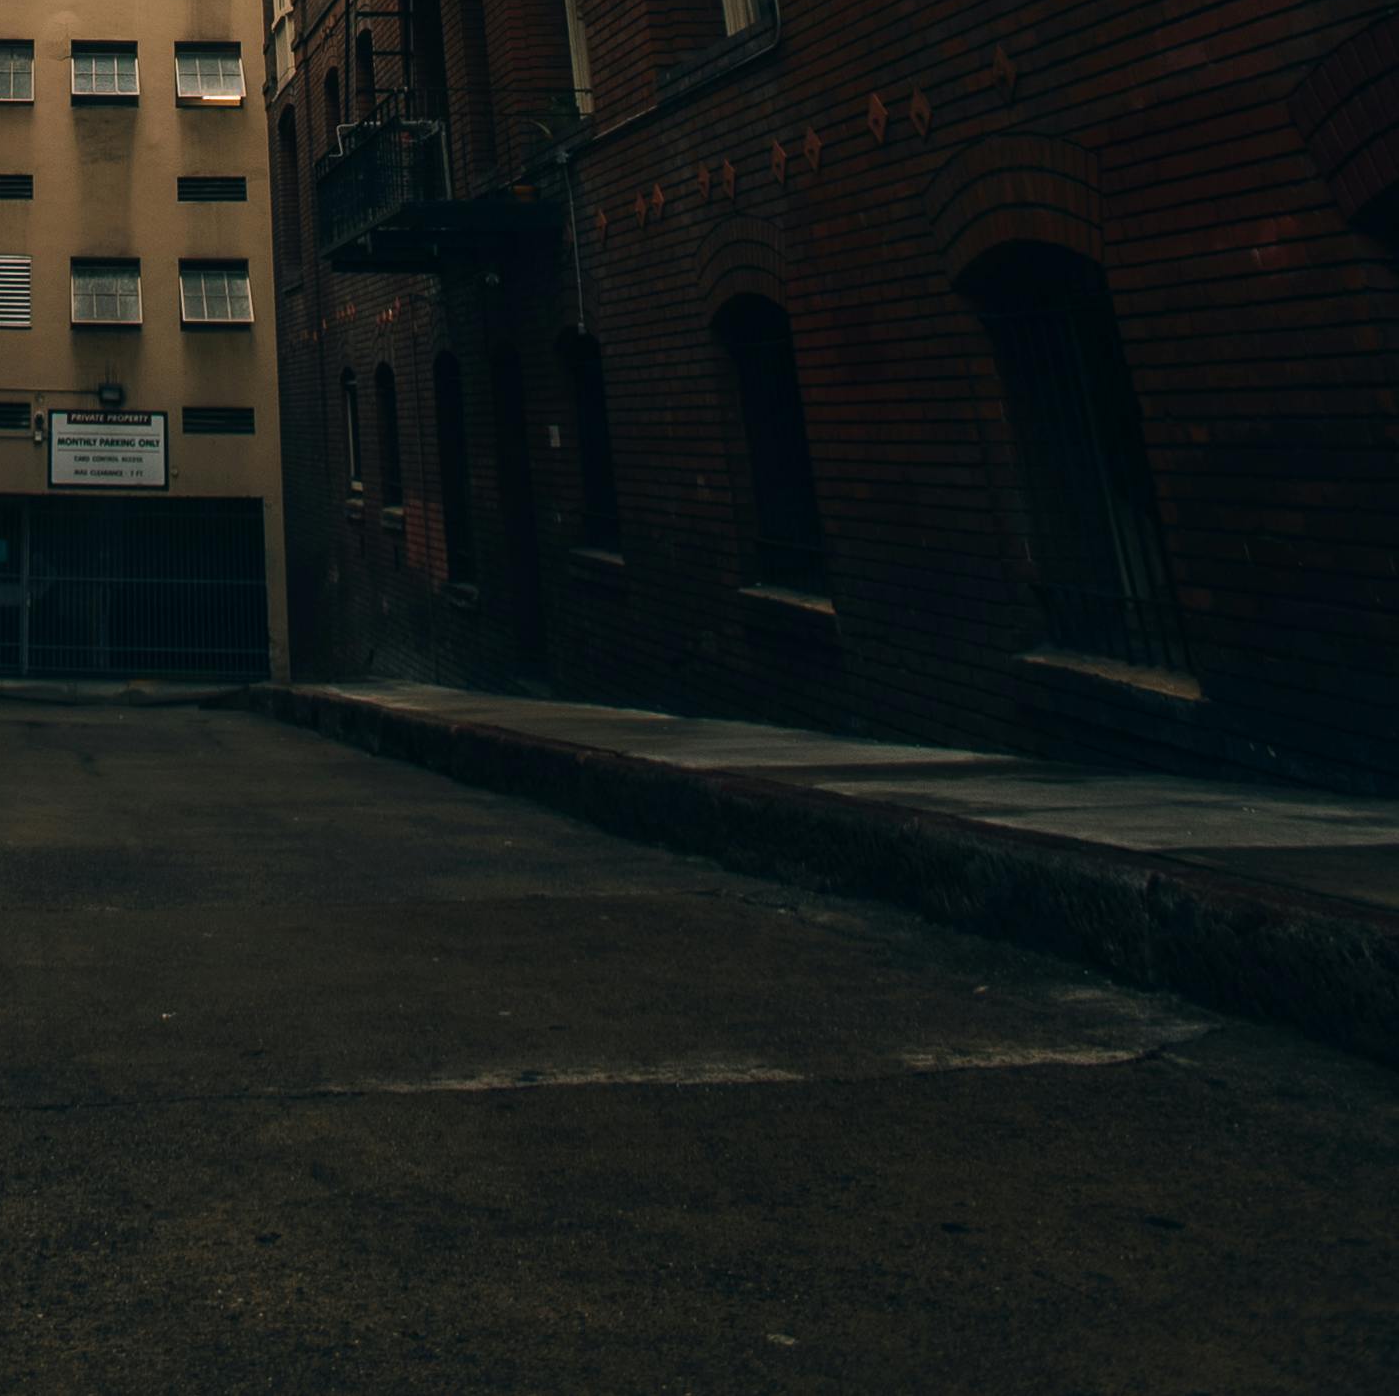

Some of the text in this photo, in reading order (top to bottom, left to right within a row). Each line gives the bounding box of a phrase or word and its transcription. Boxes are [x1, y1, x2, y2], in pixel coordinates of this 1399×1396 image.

[71, 413, 149, 423] PRIVATE PROPERTY
[57, 437, 160, 448] MONTHLY PARKING ONLY
[90, 469, 123, 477] CLEARANCE
